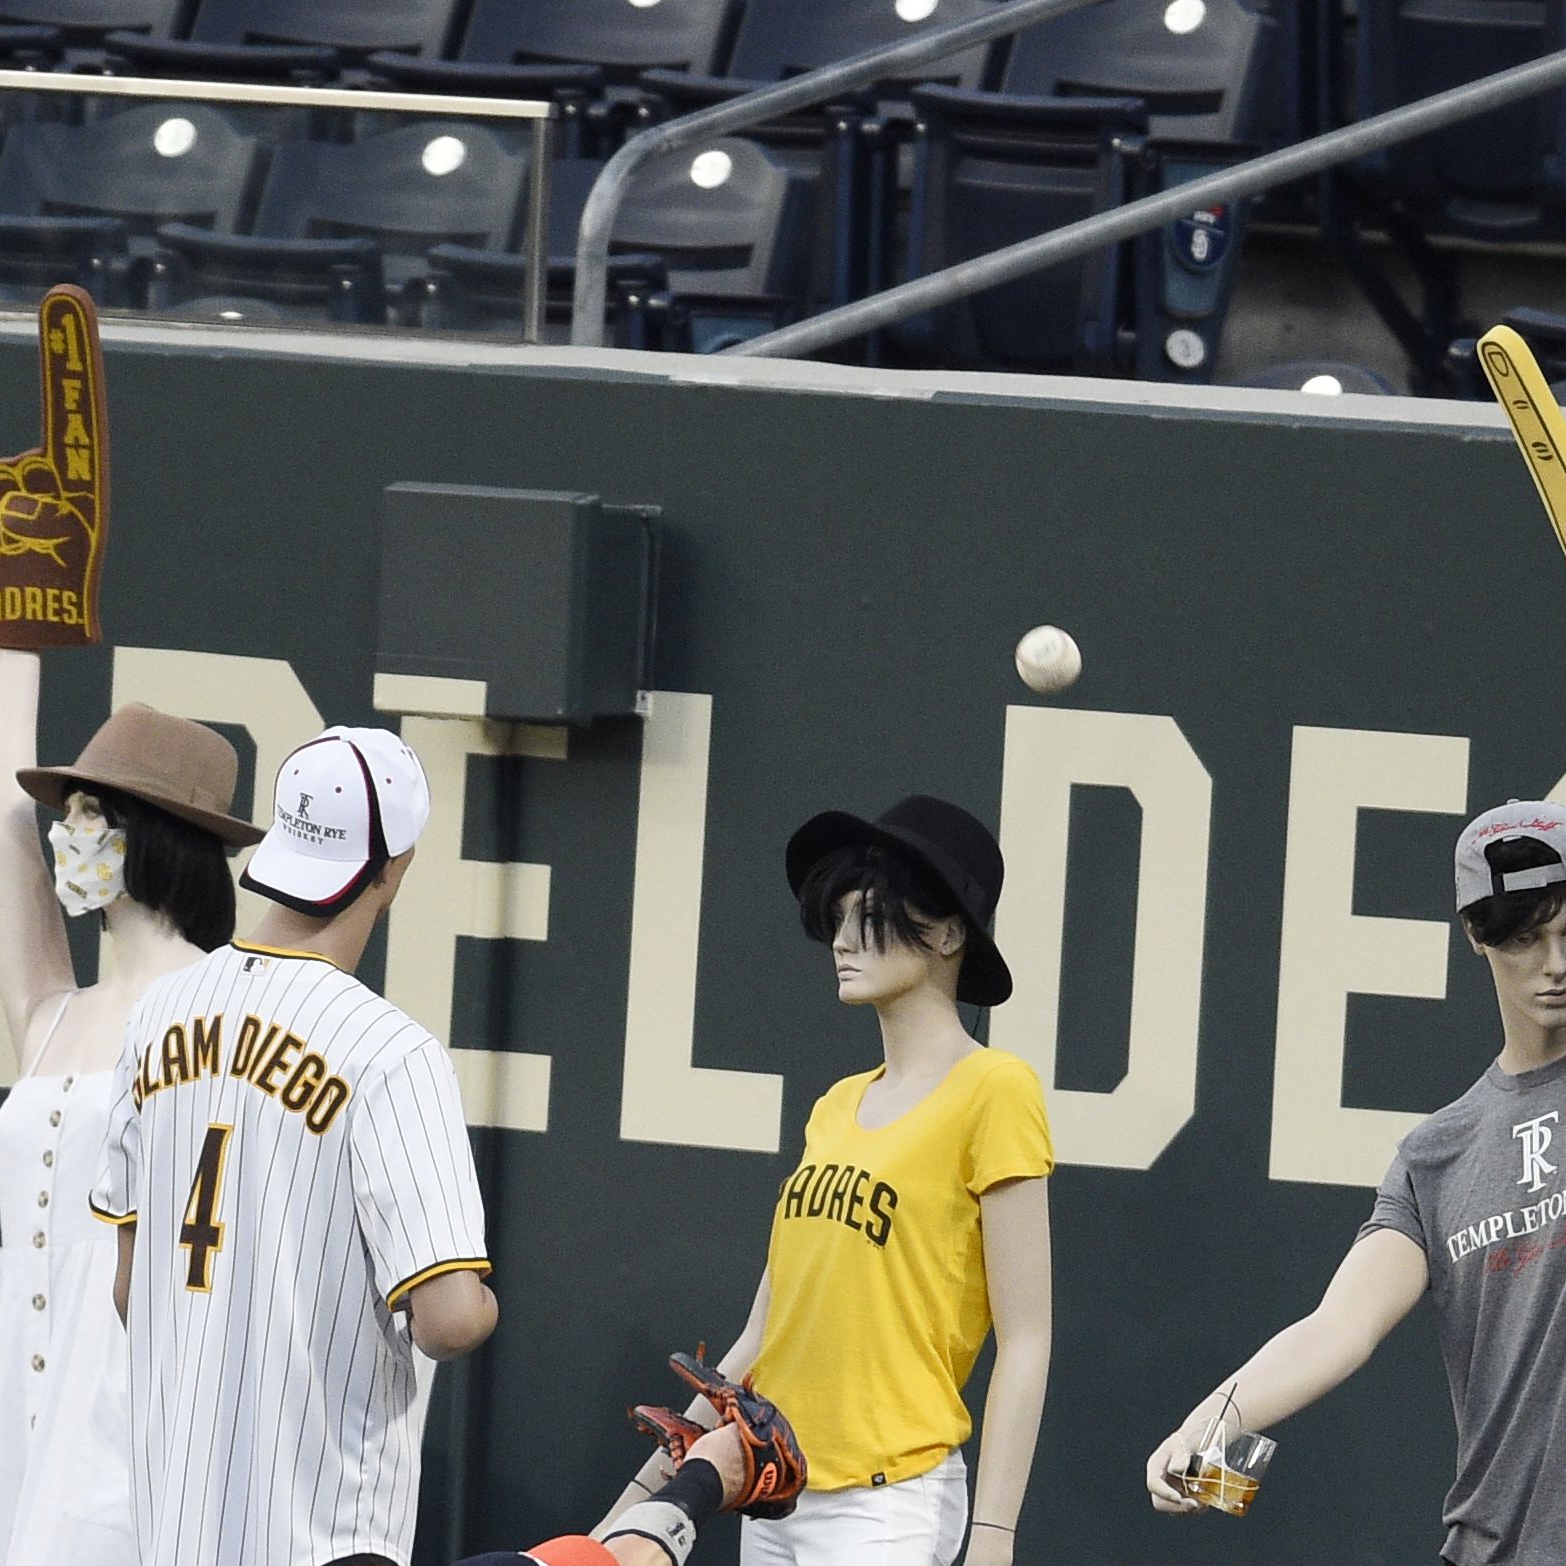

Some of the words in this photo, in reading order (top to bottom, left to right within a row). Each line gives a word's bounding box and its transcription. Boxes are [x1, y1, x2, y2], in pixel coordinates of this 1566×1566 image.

[61, 378, 92, 482] FAN
[323, 826, 347, 840] RYE
[229, 1012, 352, 1137] DIEGO
[177, 1120, 235, 1295] 4
[778, 1163, 899, 1247] ADRES
